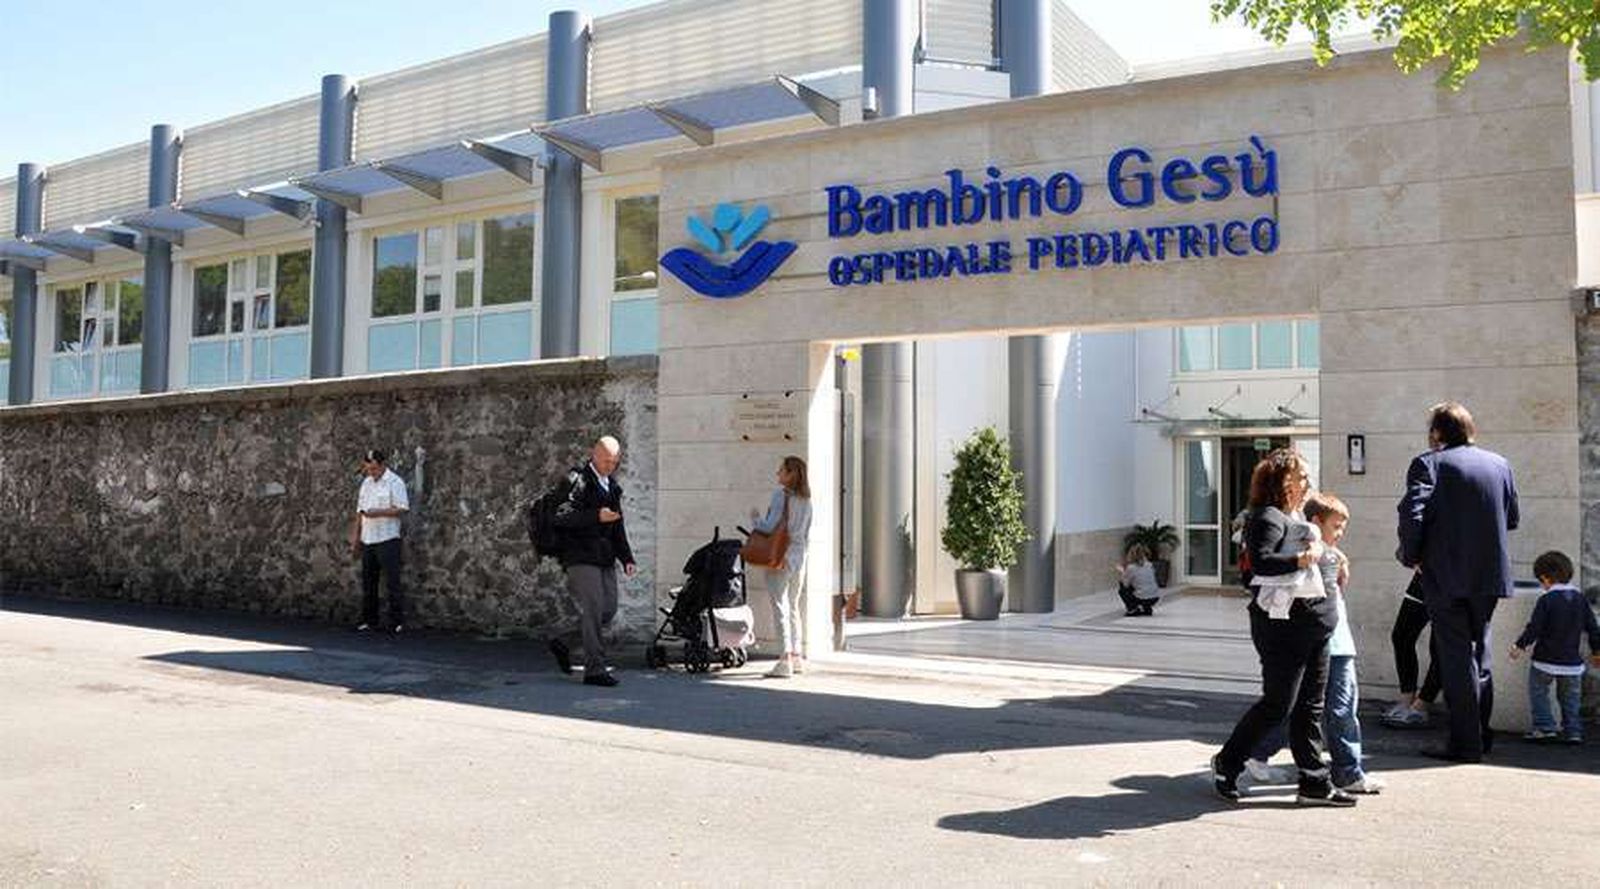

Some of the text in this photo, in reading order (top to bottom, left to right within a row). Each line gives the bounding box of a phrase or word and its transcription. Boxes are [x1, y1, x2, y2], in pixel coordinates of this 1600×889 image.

[825, 135, 1280, 237] Bambino Gesù
[827, 215, 1280, 286] OSPEDALE PEDIATRICO
